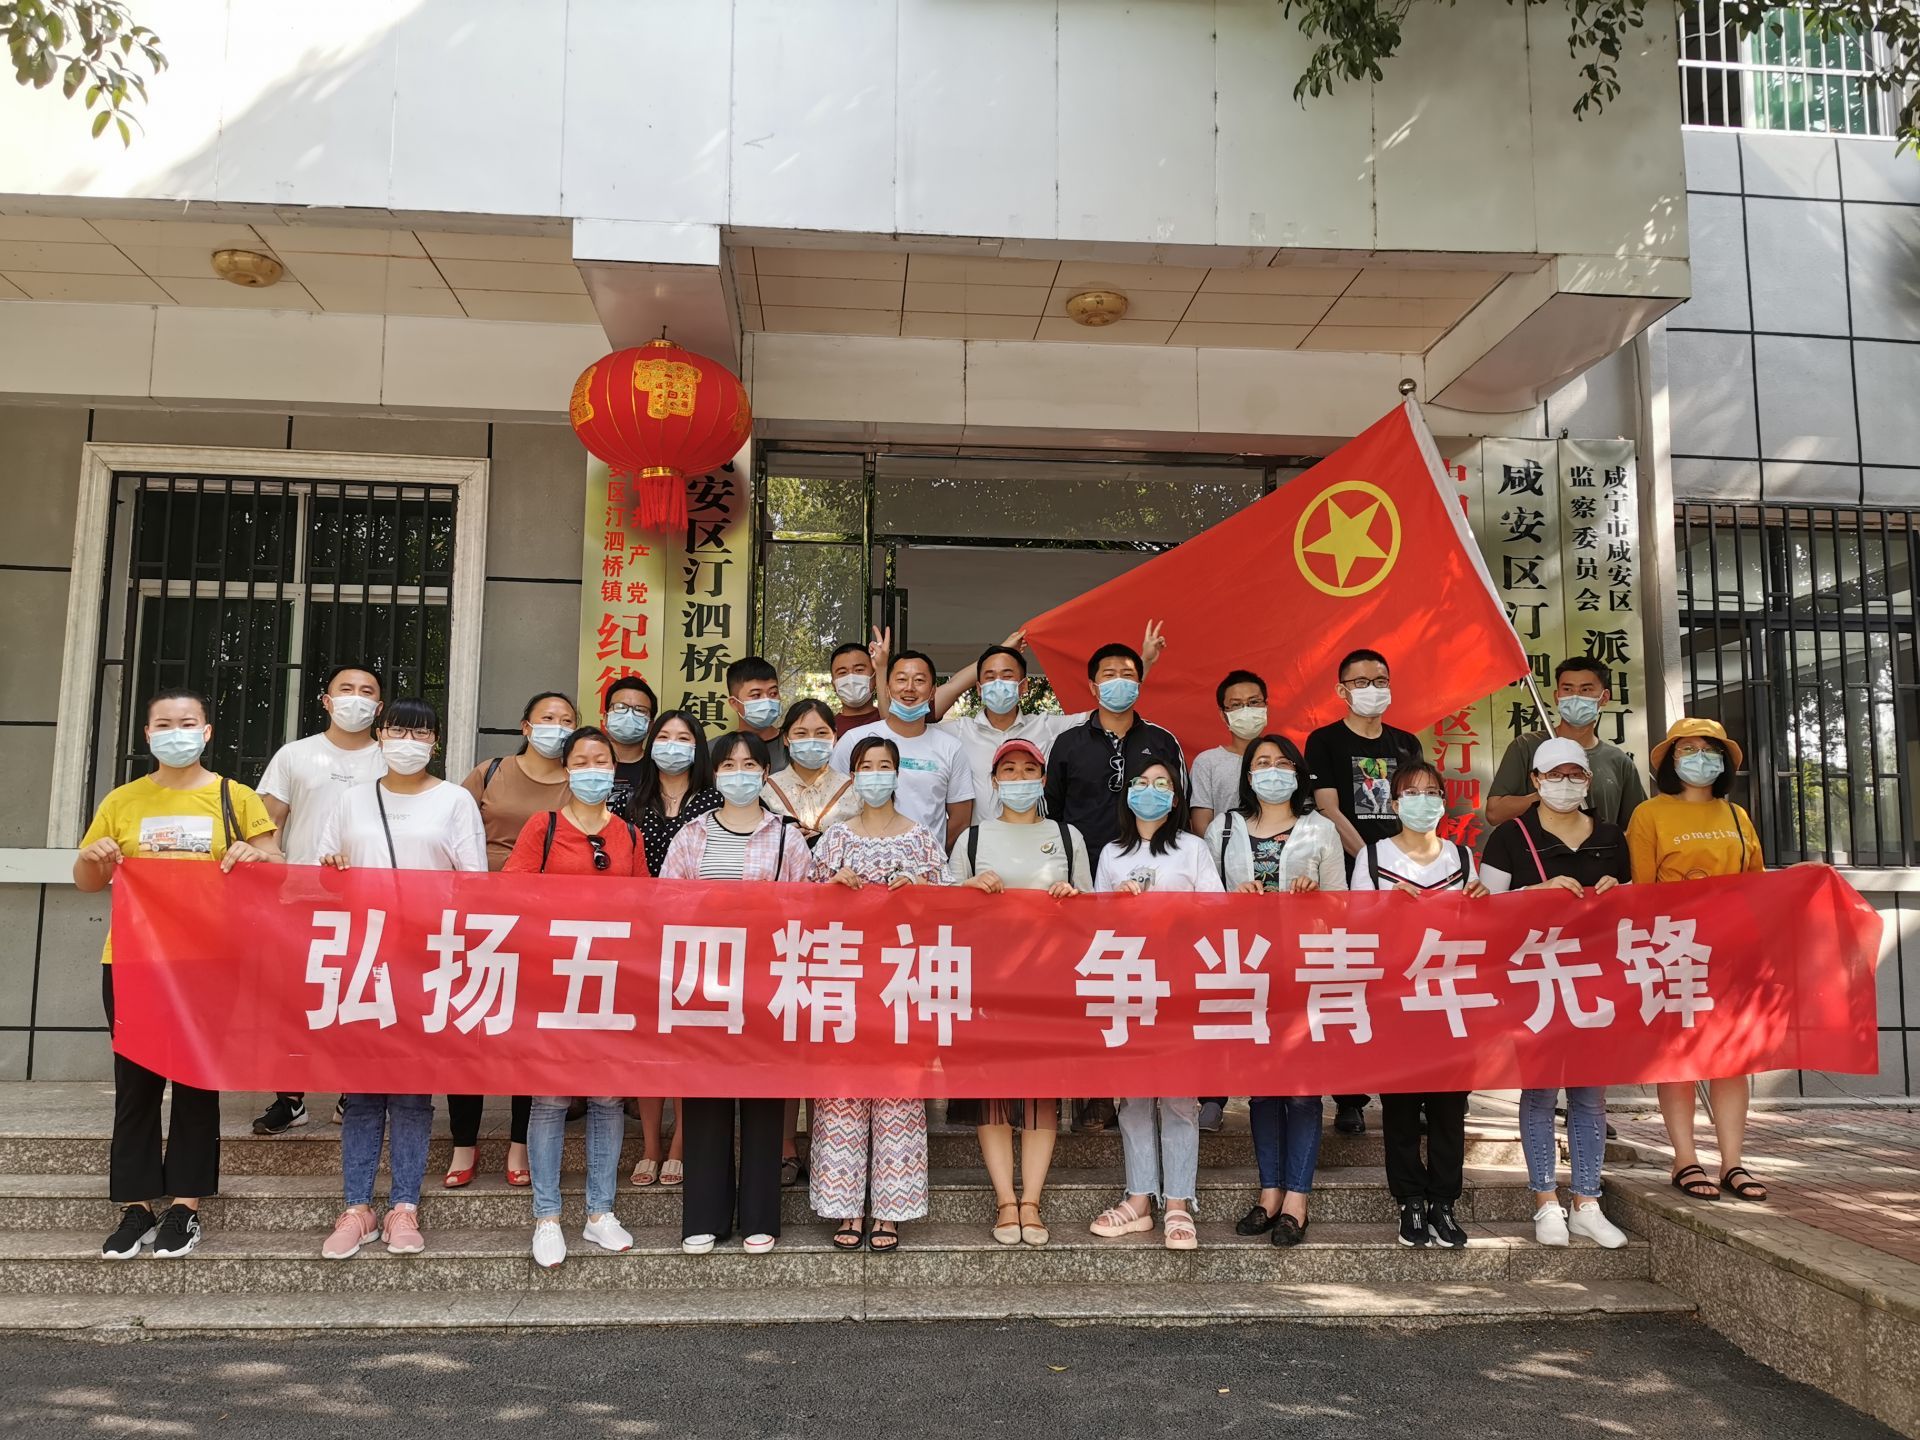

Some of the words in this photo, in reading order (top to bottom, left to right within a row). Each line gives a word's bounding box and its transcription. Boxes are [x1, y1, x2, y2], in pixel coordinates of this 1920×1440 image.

[678, 460, 736, 731] 安区汀泗桥镇
[1569, 465, 1601, 612] 监察委员会
[1603, 465, 1634, 612] 咸宁市咸安区
[1582, 628, 1635, 763] 派出汀
[1431, 705, 1483, 876] 区汀泗桥
[305, 909, 972, 1046] 弘扬五四精神
[1074, 916, 1715, 1048] 争当青年先锋
